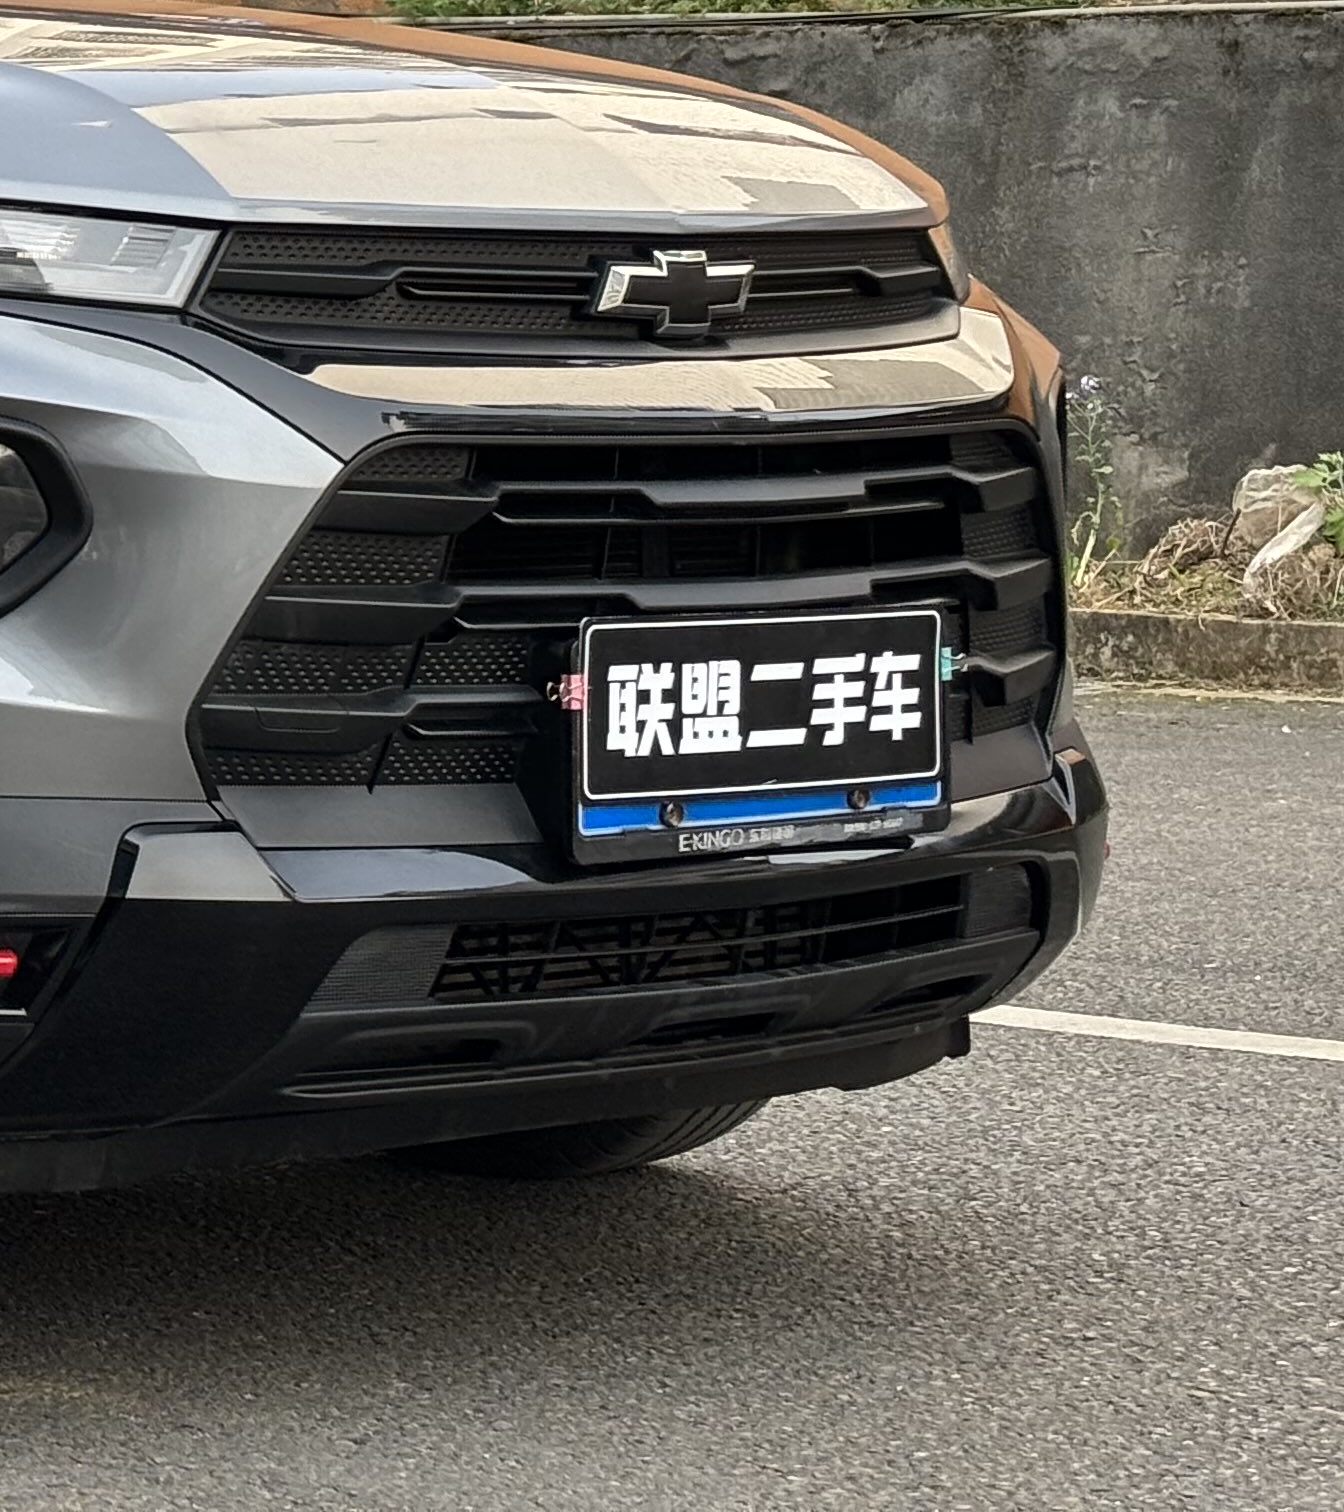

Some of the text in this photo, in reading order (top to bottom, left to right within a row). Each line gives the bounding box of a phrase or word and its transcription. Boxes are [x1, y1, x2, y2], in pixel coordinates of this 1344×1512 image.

[606, 651, 922, 757] 联盟二手车
